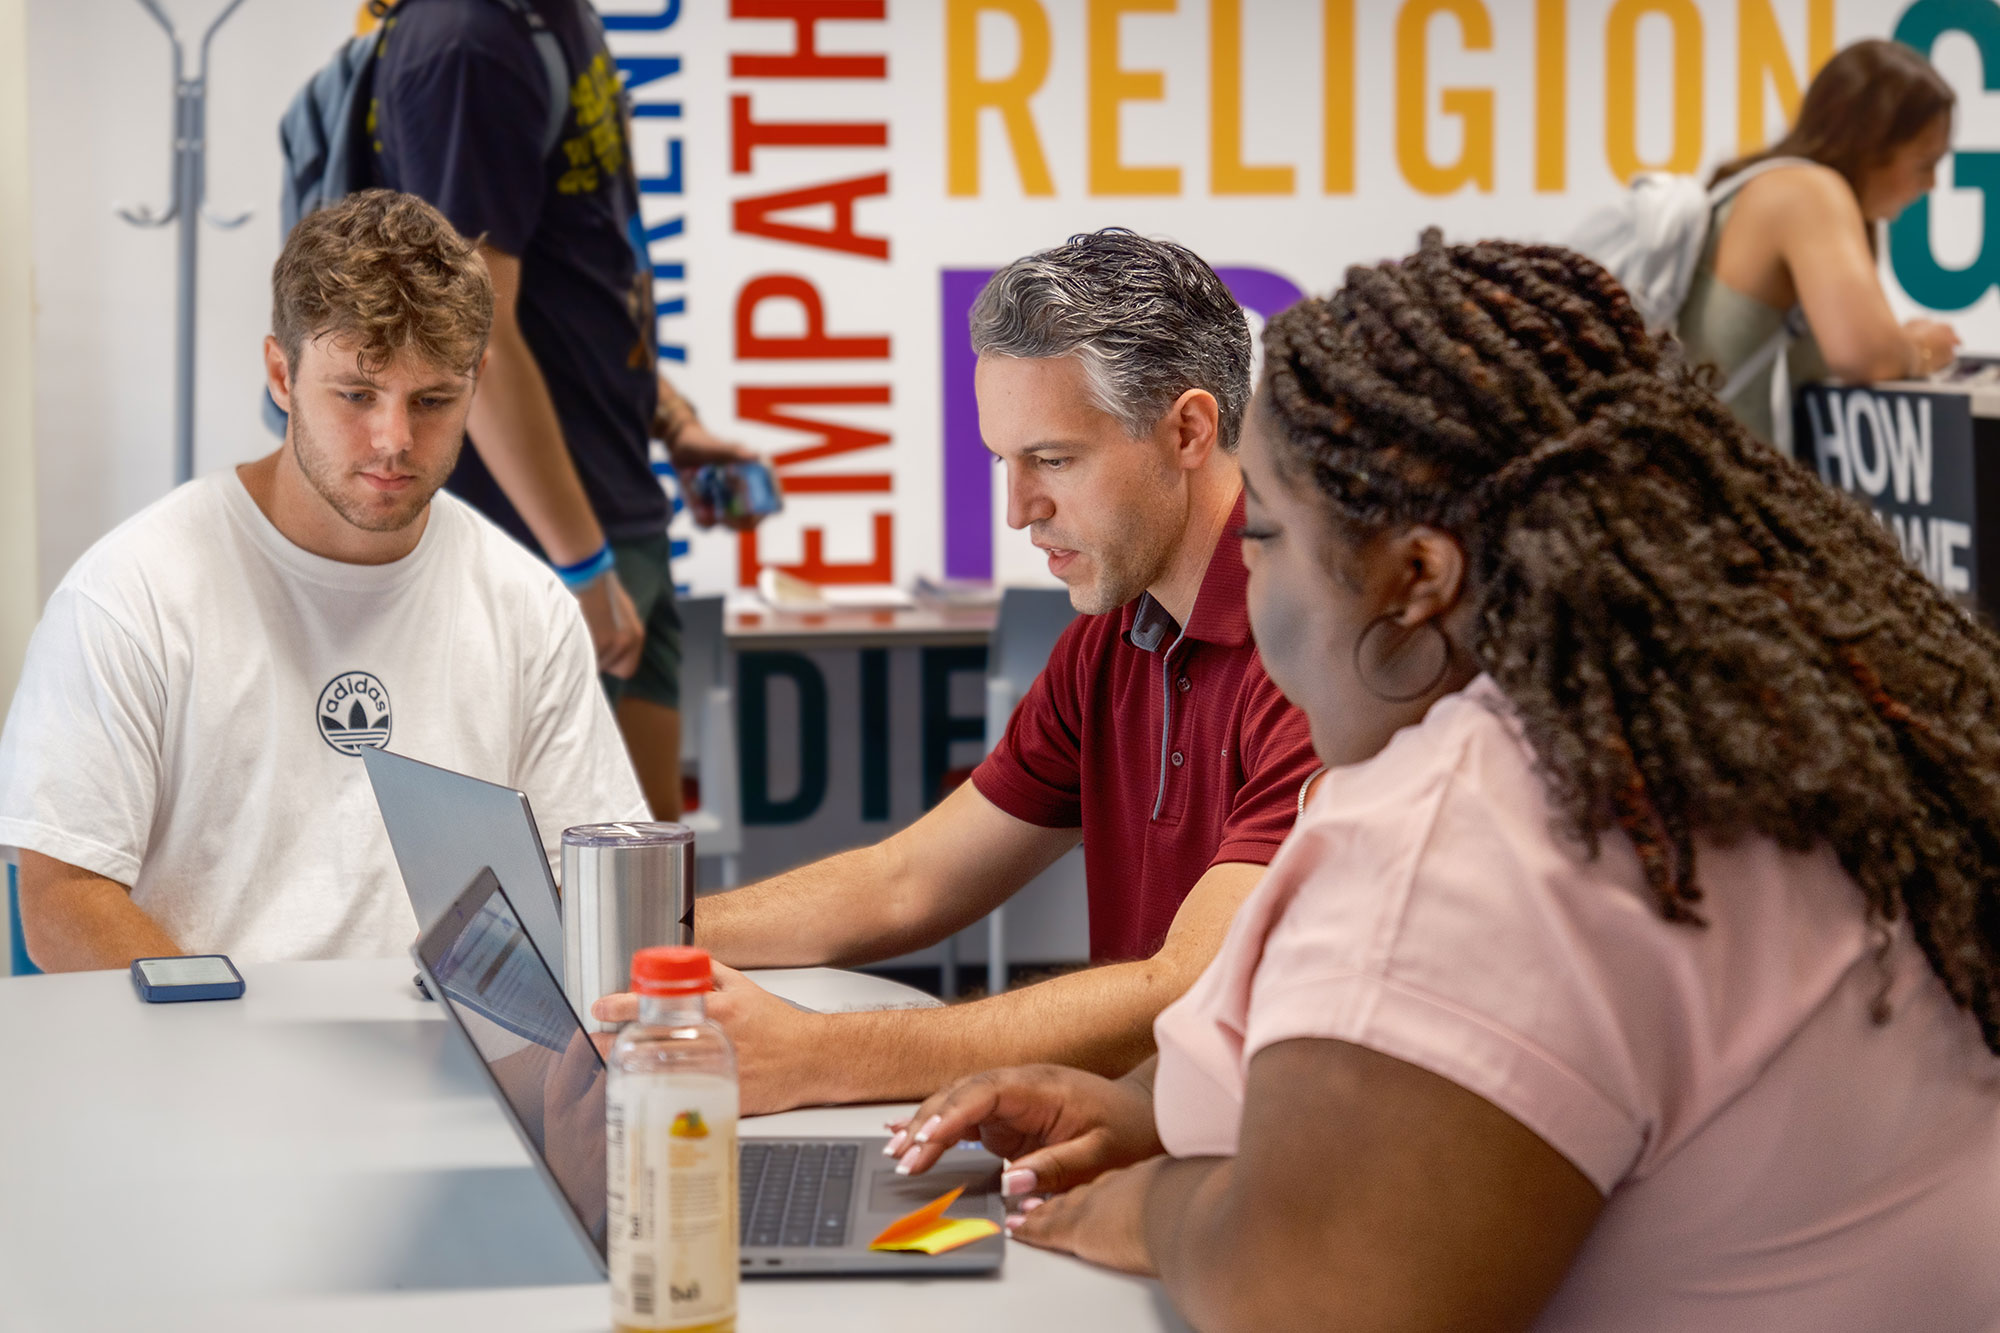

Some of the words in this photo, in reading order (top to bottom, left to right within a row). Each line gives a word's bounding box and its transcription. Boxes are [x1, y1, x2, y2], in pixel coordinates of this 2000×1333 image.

[945, 0, 1837, 197] RELIGION
[1806, 388, 1932, 505] HOW
[326, 677, 386, 713] adidas
